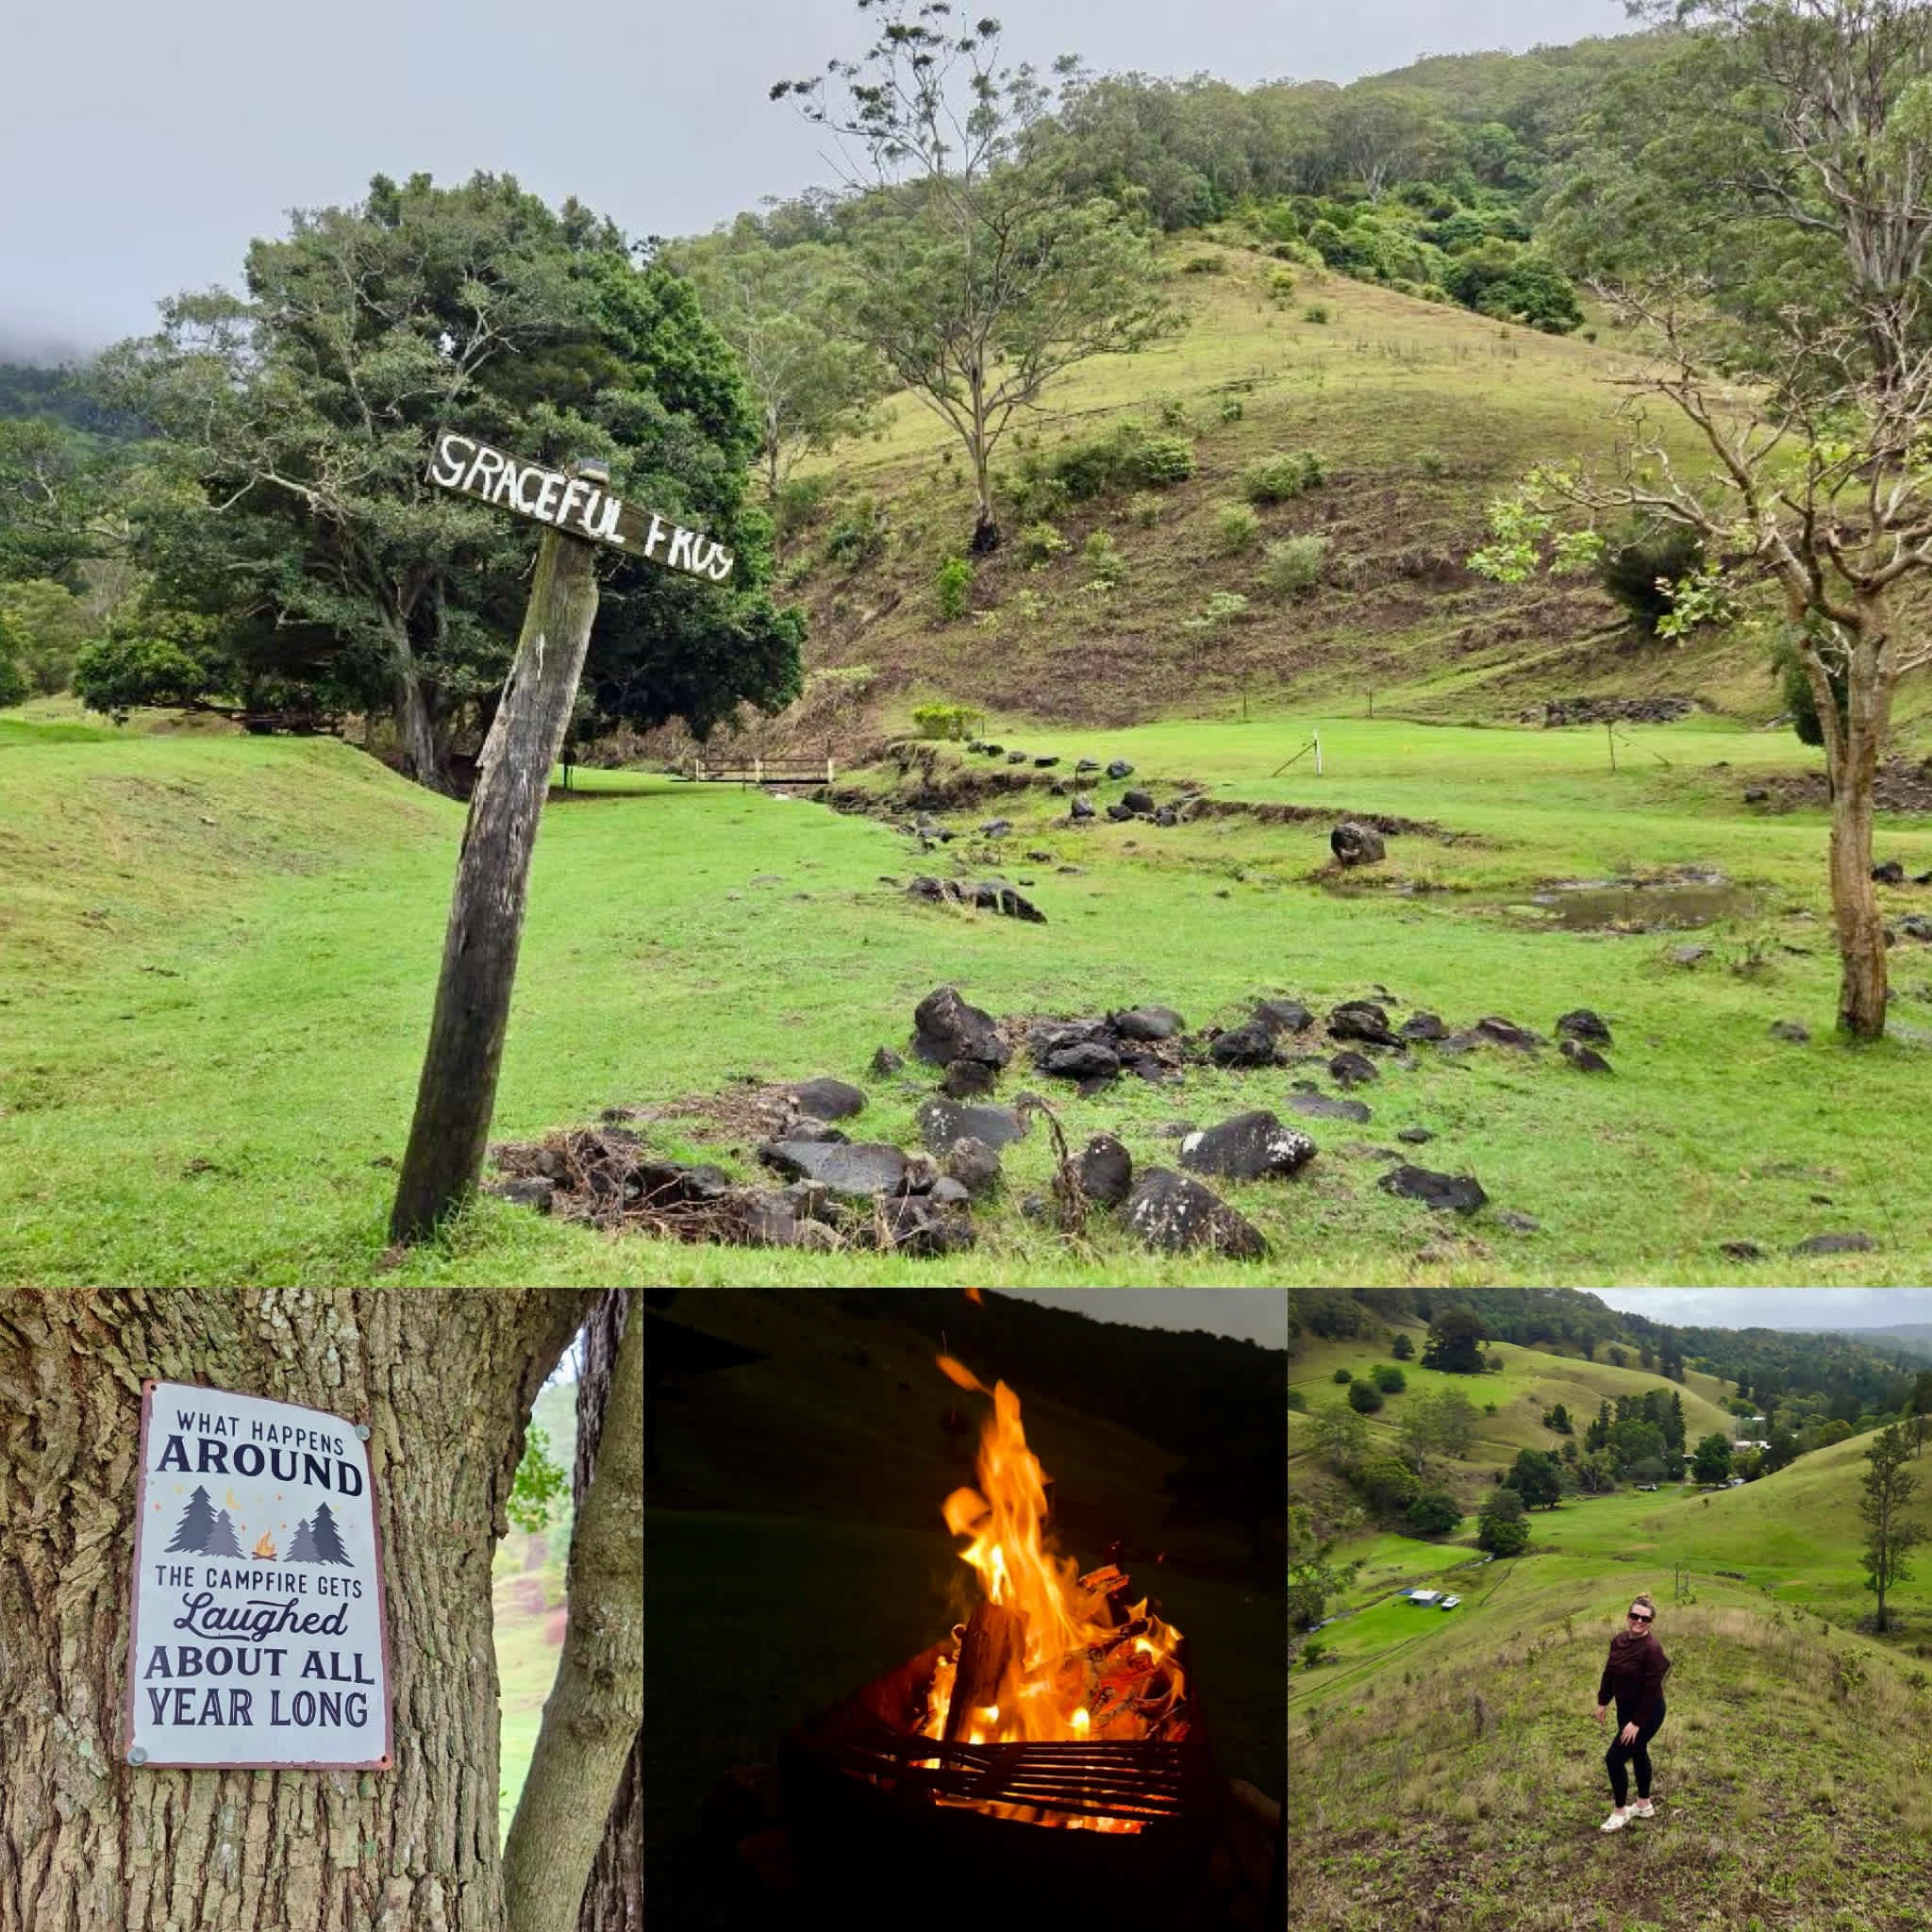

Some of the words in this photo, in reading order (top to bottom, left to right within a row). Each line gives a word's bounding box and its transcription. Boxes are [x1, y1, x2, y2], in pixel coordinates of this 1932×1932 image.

[432, 435, 625, 543] GRACEFUL
[176, 1409, 240, 1438] WHAT
[252, 1420, 343, 1457] HAPPENS
[155, 1434, 362, 1497] AROUND
[156, 1565, 194, 1587] THE
[206, 1568, 308, 1593] CAMPFIRE
[317, 1575, 362, 1599] GETS
[173, 1591, 348, 1642] Laughed
[143, 1645, 287, 1680] ABOUT
[300, 1650, 375, 1685] ALL
[146, 1687, 254, 1726] YEAR
[270, 1690, 368, 1728] LONG
